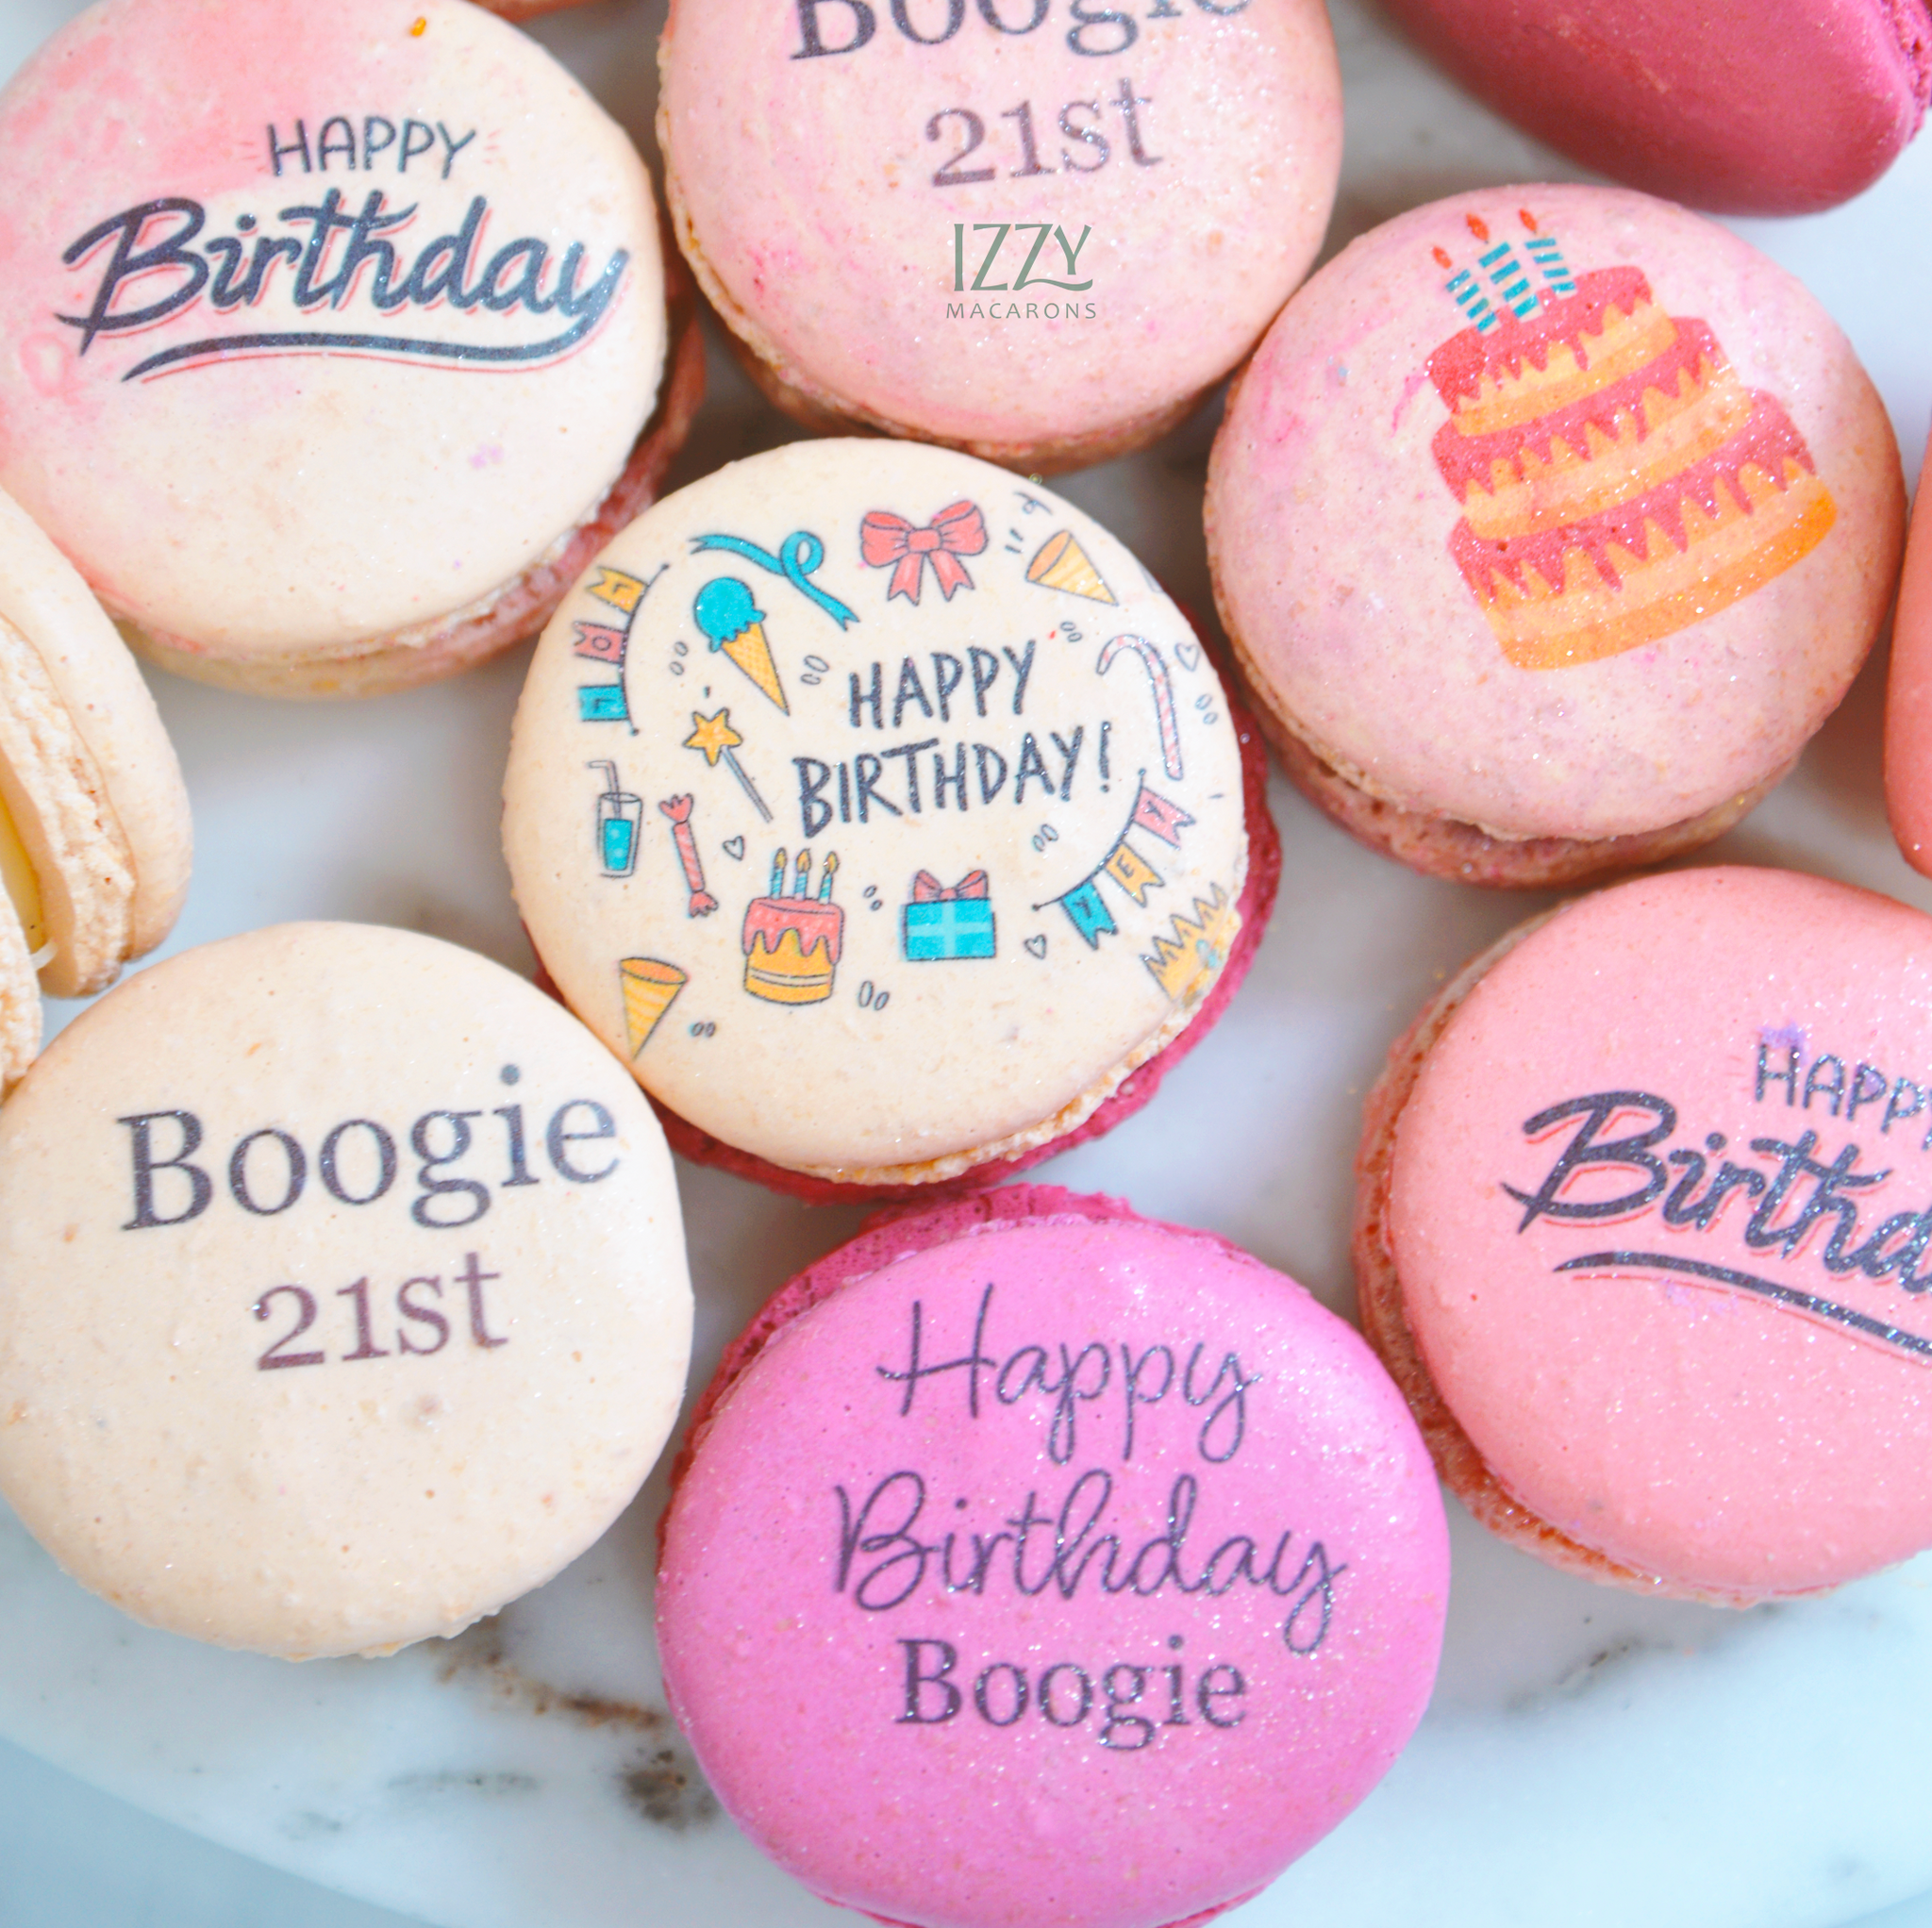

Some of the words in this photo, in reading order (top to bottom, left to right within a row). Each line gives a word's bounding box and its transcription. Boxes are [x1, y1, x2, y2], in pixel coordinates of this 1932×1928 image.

[791, 0, 1252, 59] Bog
[267, 116, 475, 179] HAPPY
[925, 77, 1163, 187] 21st
[55, 188, 630, 382] Birthday
[849, 639, 1036, 729] HAPPY
[792, 721, 1111, 839] BIRTHDAY!
[117, 1064, 620, 1230] Boogie
[1755, 1041, 1932, 1152] HAPP
[1500, 1090, 1932, 1355] Birthd
[252, 1252, 508, 1371] 21st
[875, 1283, 1263, 1464] Happy
[834, 1469, 1348, 1654] Birthday
[894, 1635, 1247, 1751] Boogie
